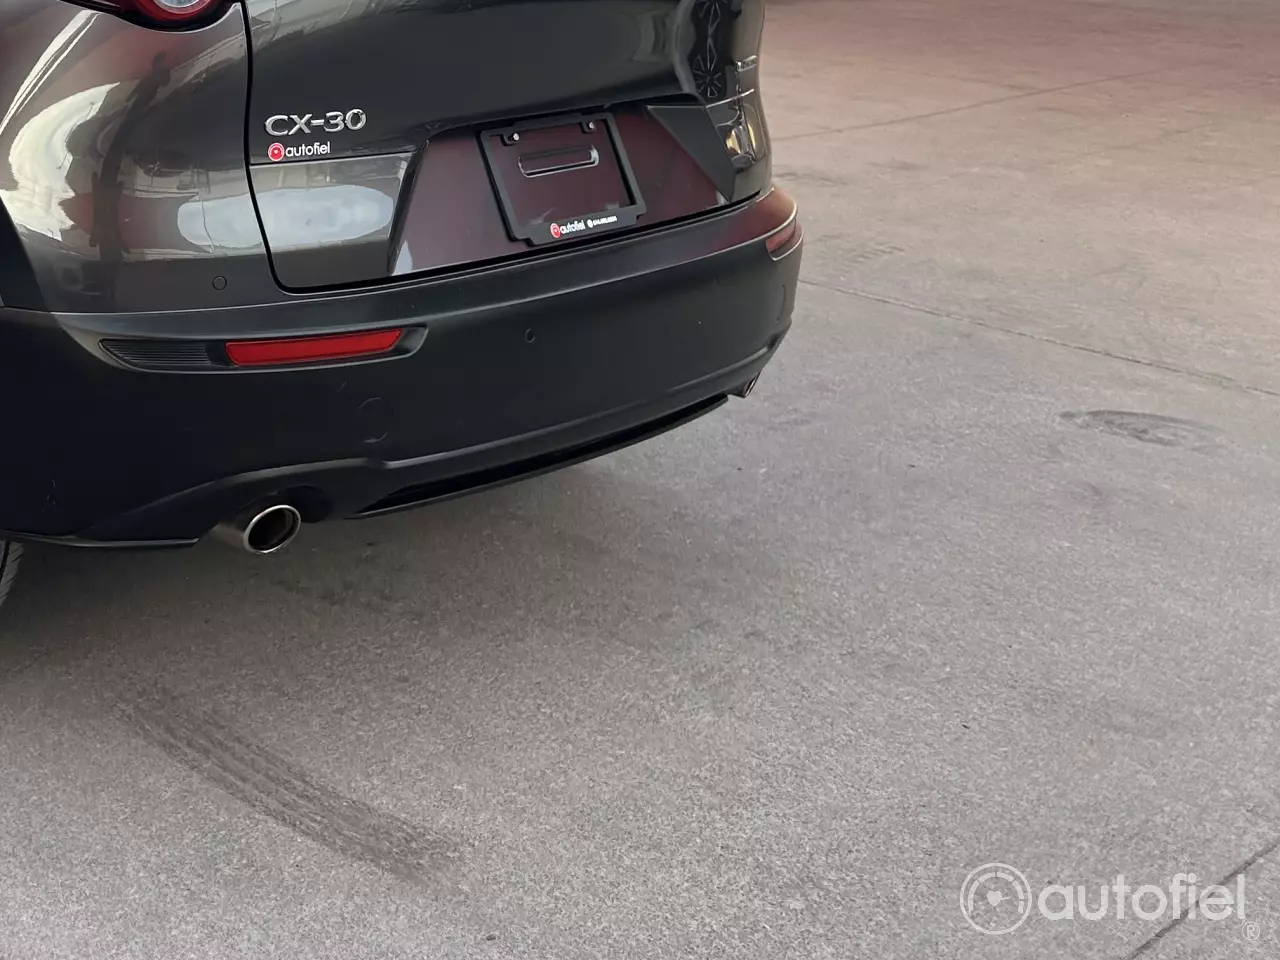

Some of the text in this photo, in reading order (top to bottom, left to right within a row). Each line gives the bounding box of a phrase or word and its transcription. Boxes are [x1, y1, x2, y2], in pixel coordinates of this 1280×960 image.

[264, 108, 367, 136] CX-30
[285, 141, 331, 157] autofiel
[559, 219, 586, 234] autofiel
